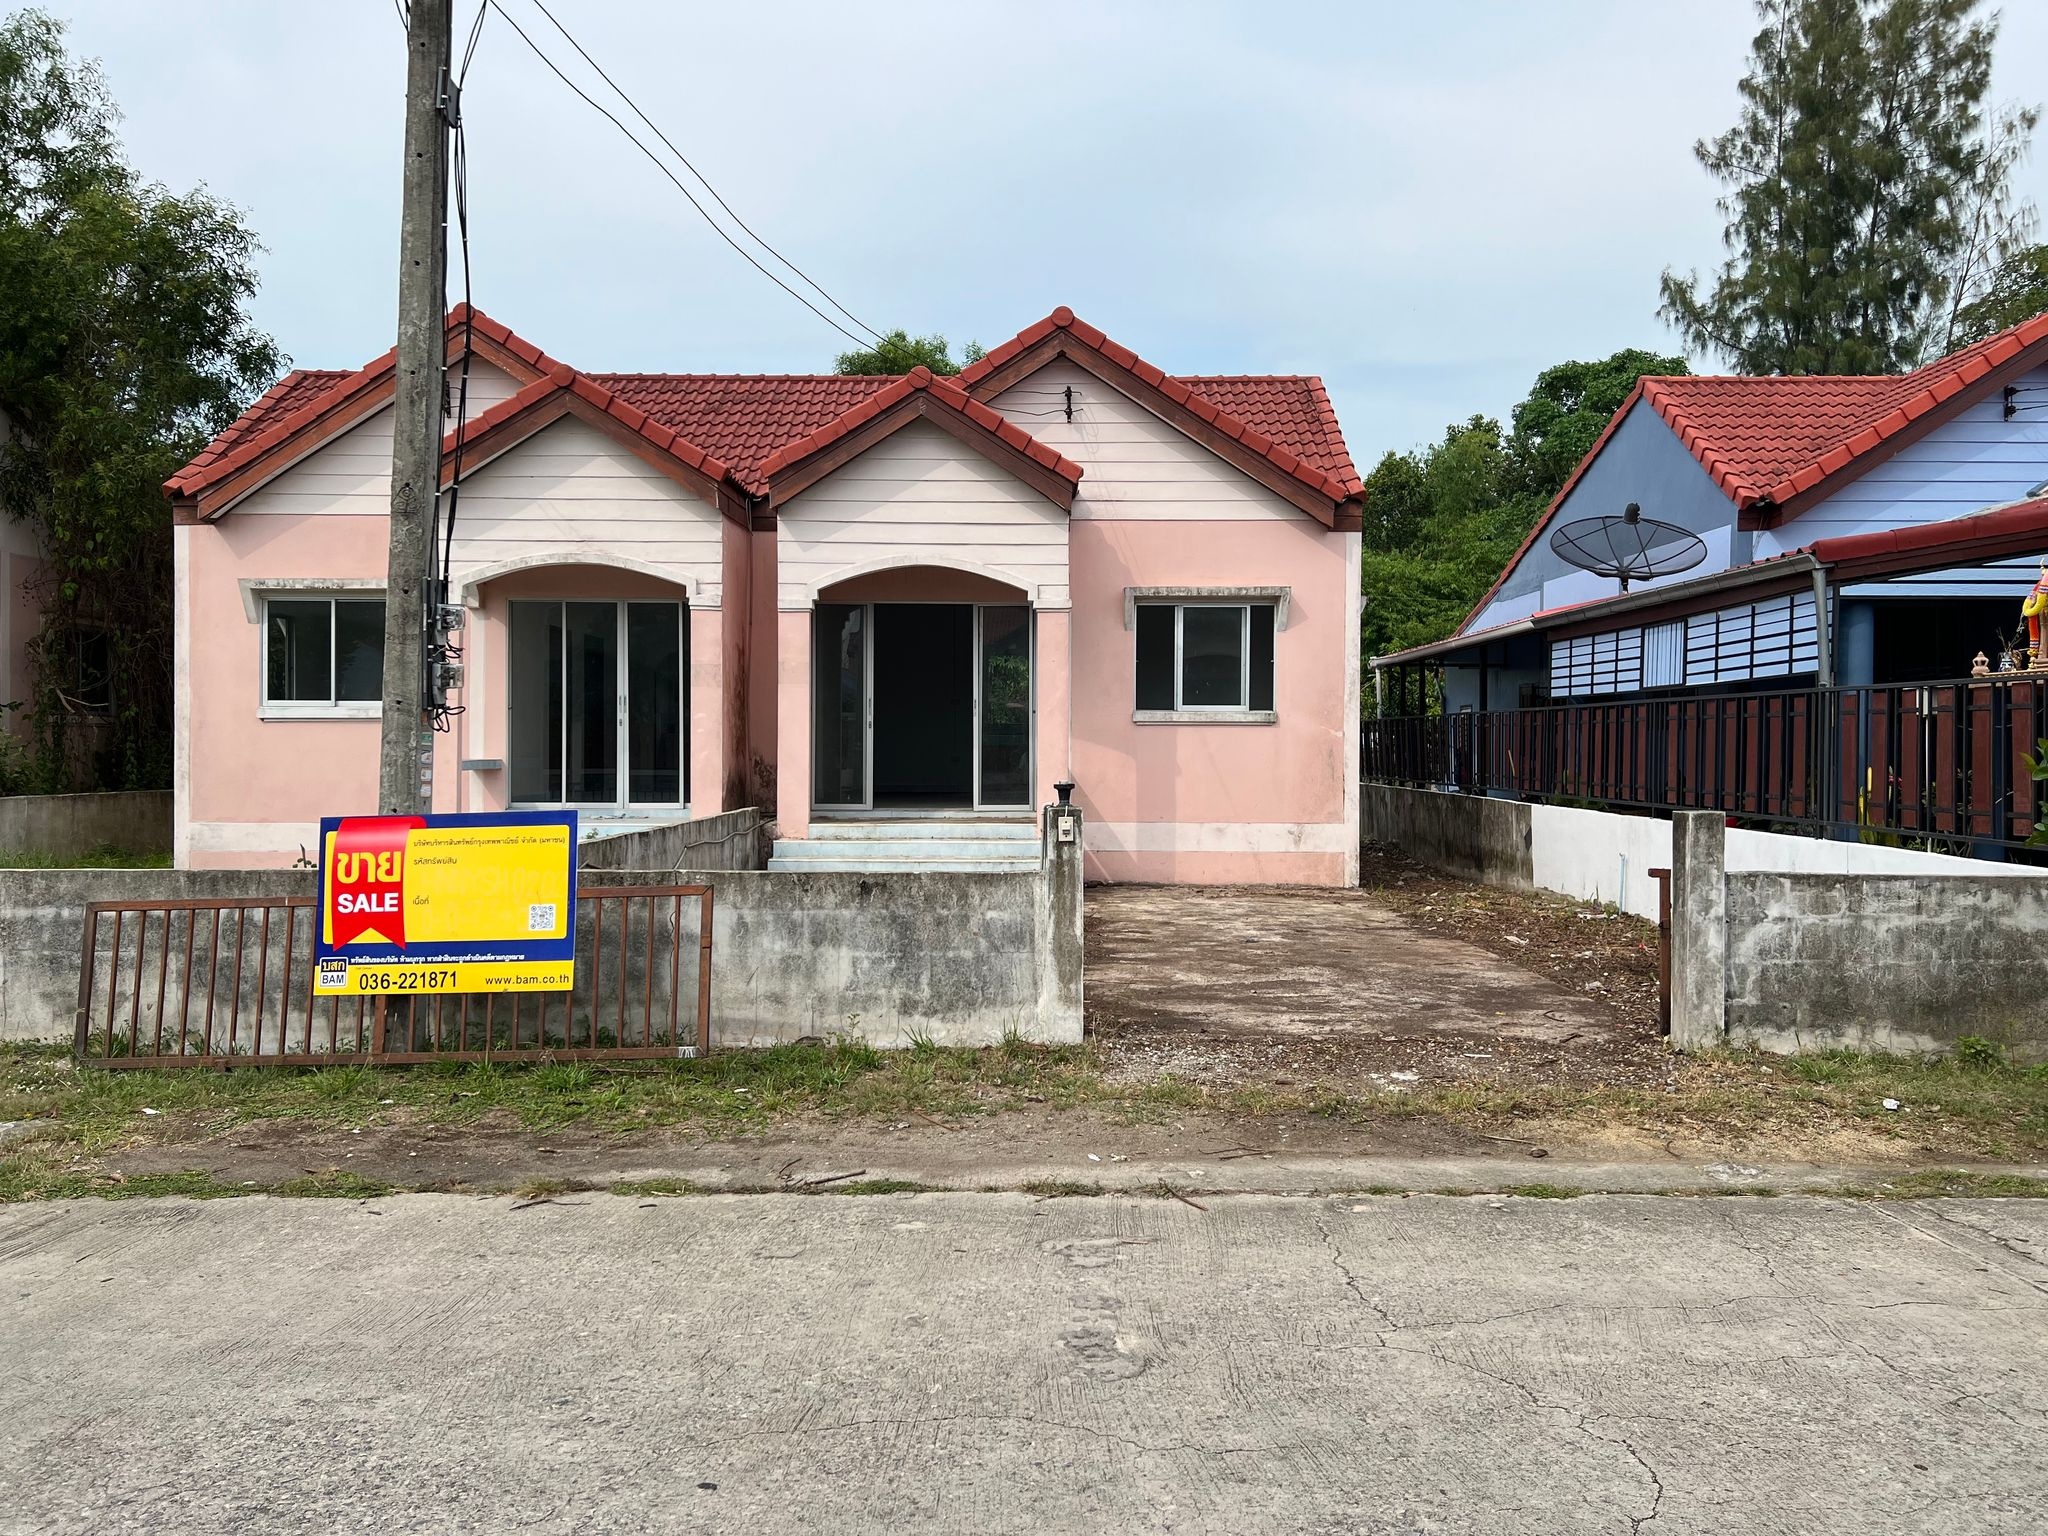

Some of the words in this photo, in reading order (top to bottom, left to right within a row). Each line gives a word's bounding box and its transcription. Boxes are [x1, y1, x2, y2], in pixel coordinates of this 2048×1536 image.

[413, 856, 458, 866] รหัสทรัพย์สิน
[337, 851, 402, 884] ขาย
[337, 892, 399, 914] SALE
[322, 960, 345, 971] บสก
[322, 974, 344, 984] BAM
[359, 971, 457, 991] 036-221871
[485, 974, 570, 985] www.bam.co.th
